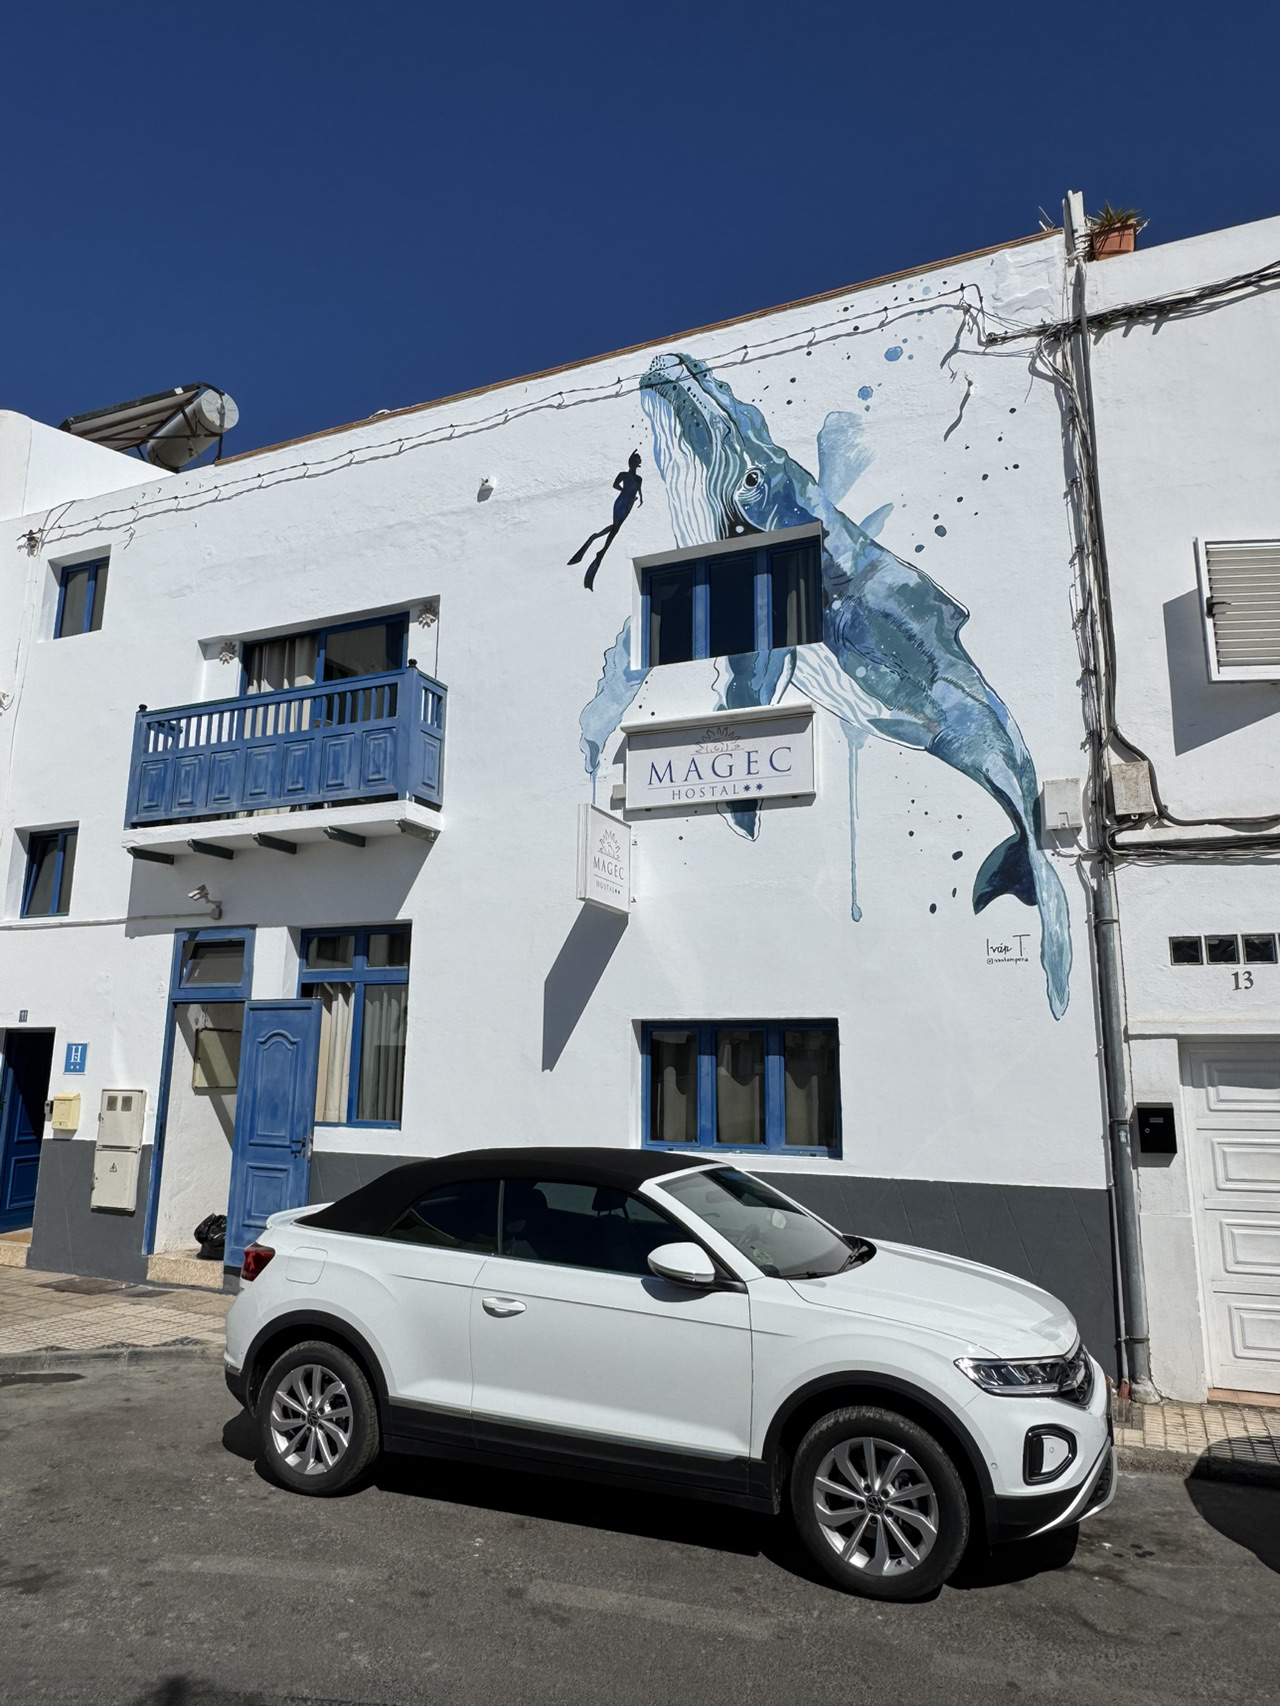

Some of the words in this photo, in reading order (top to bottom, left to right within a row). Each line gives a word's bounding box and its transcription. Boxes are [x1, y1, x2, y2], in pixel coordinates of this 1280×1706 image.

[648, 746, 793, 786] MAGEC
[672, 783, 739, 800] HOSTAL
[593, 855, 625, 880] MAGEC
[595, 880, 615, 894] HOSTAL
[1230, 970, 1255, 991] 13
